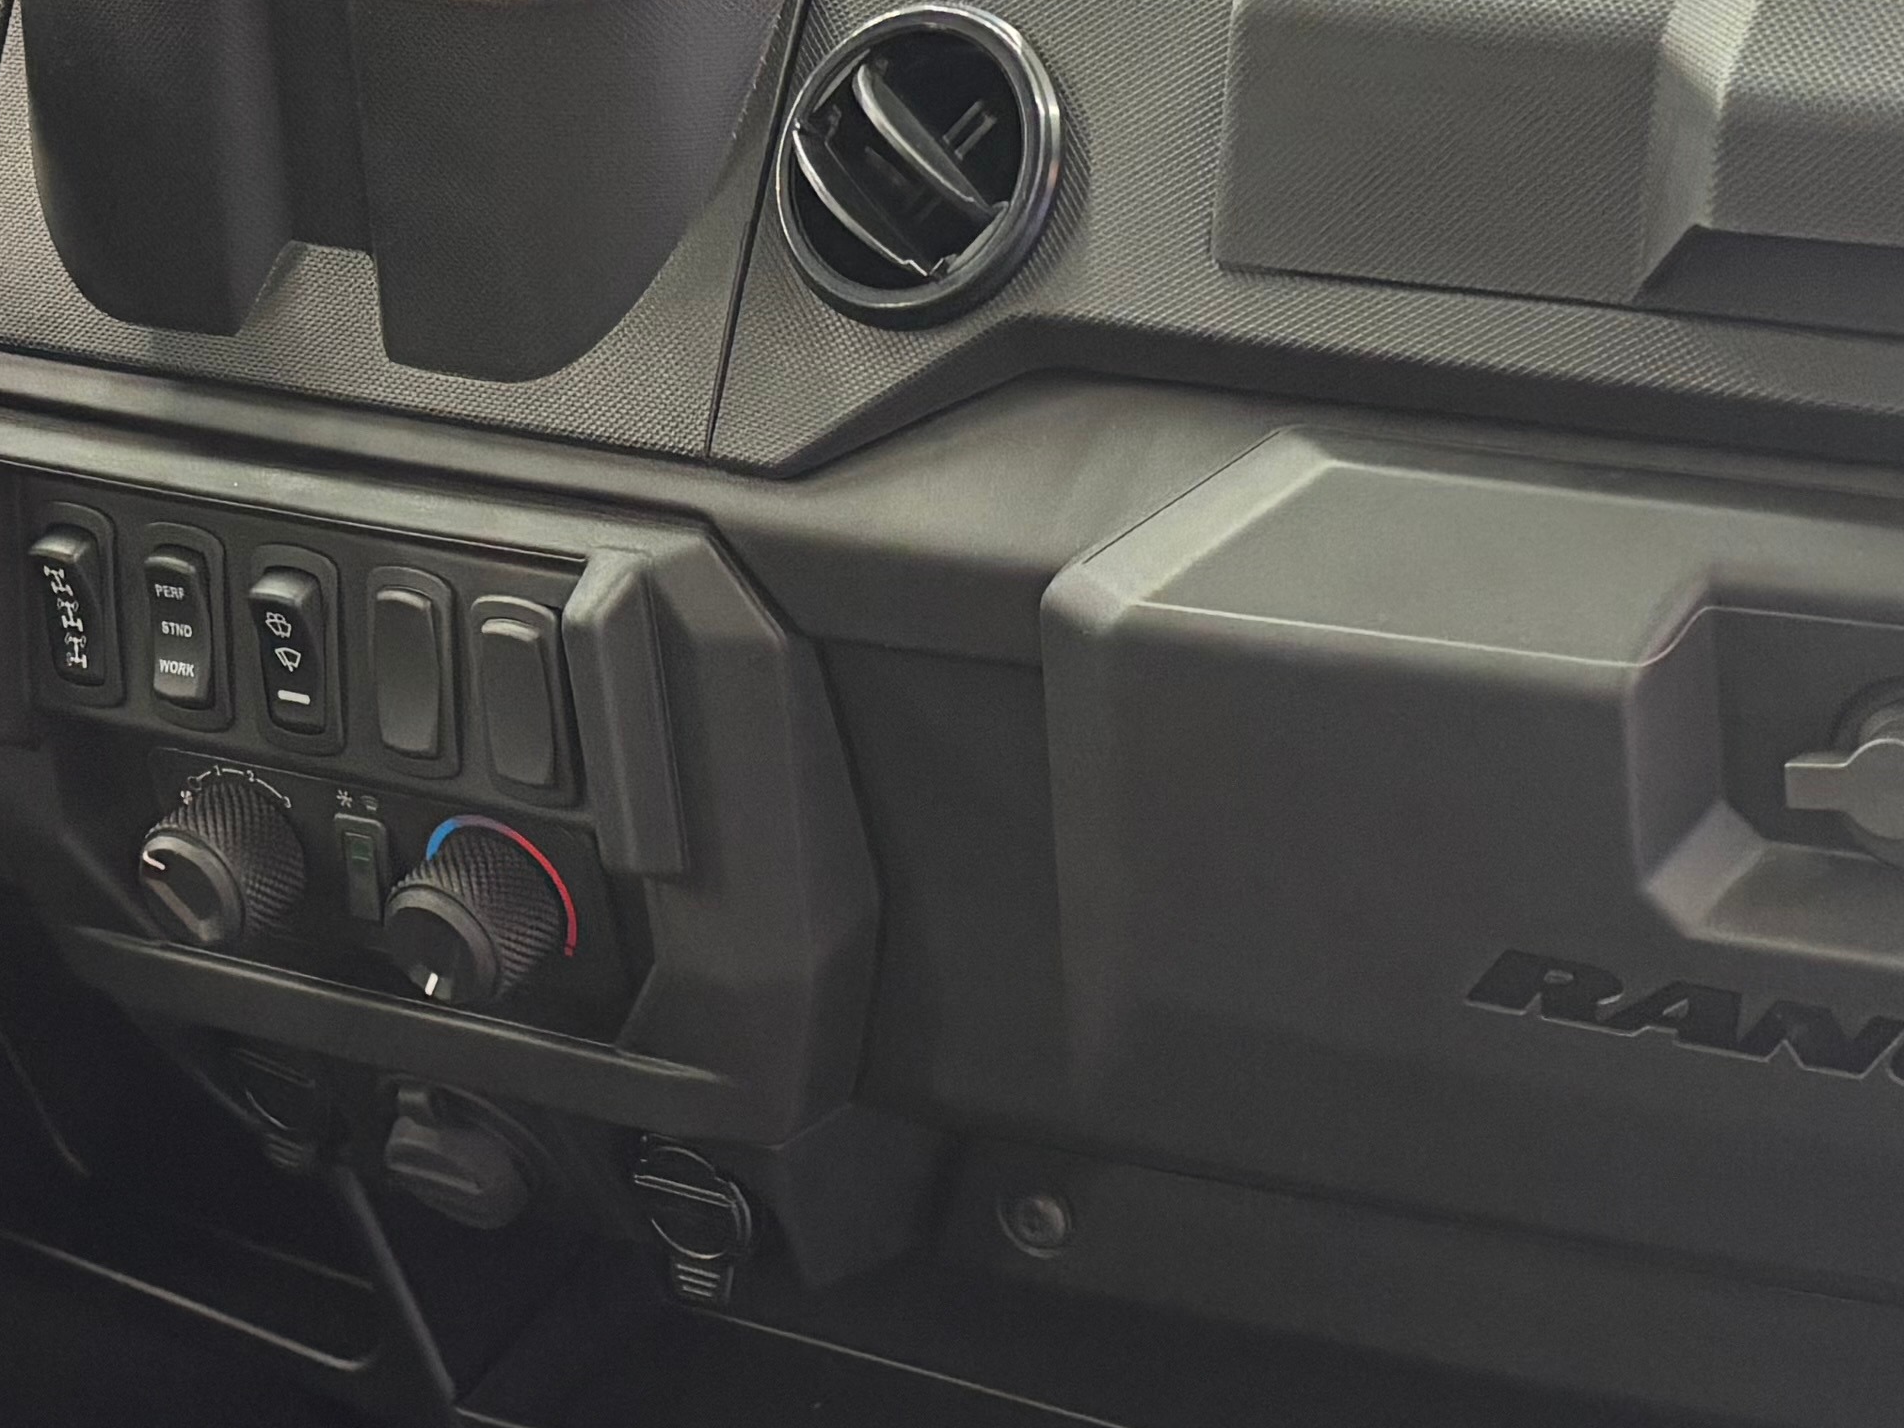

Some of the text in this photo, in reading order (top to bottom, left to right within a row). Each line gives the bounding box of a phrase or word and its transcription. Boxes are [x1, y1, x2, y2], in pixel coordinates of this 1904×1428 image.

[154, 583, 185, 601] PERF
[161, 621, 193, 638] STND
[159, 659, 195, 678] WORK
